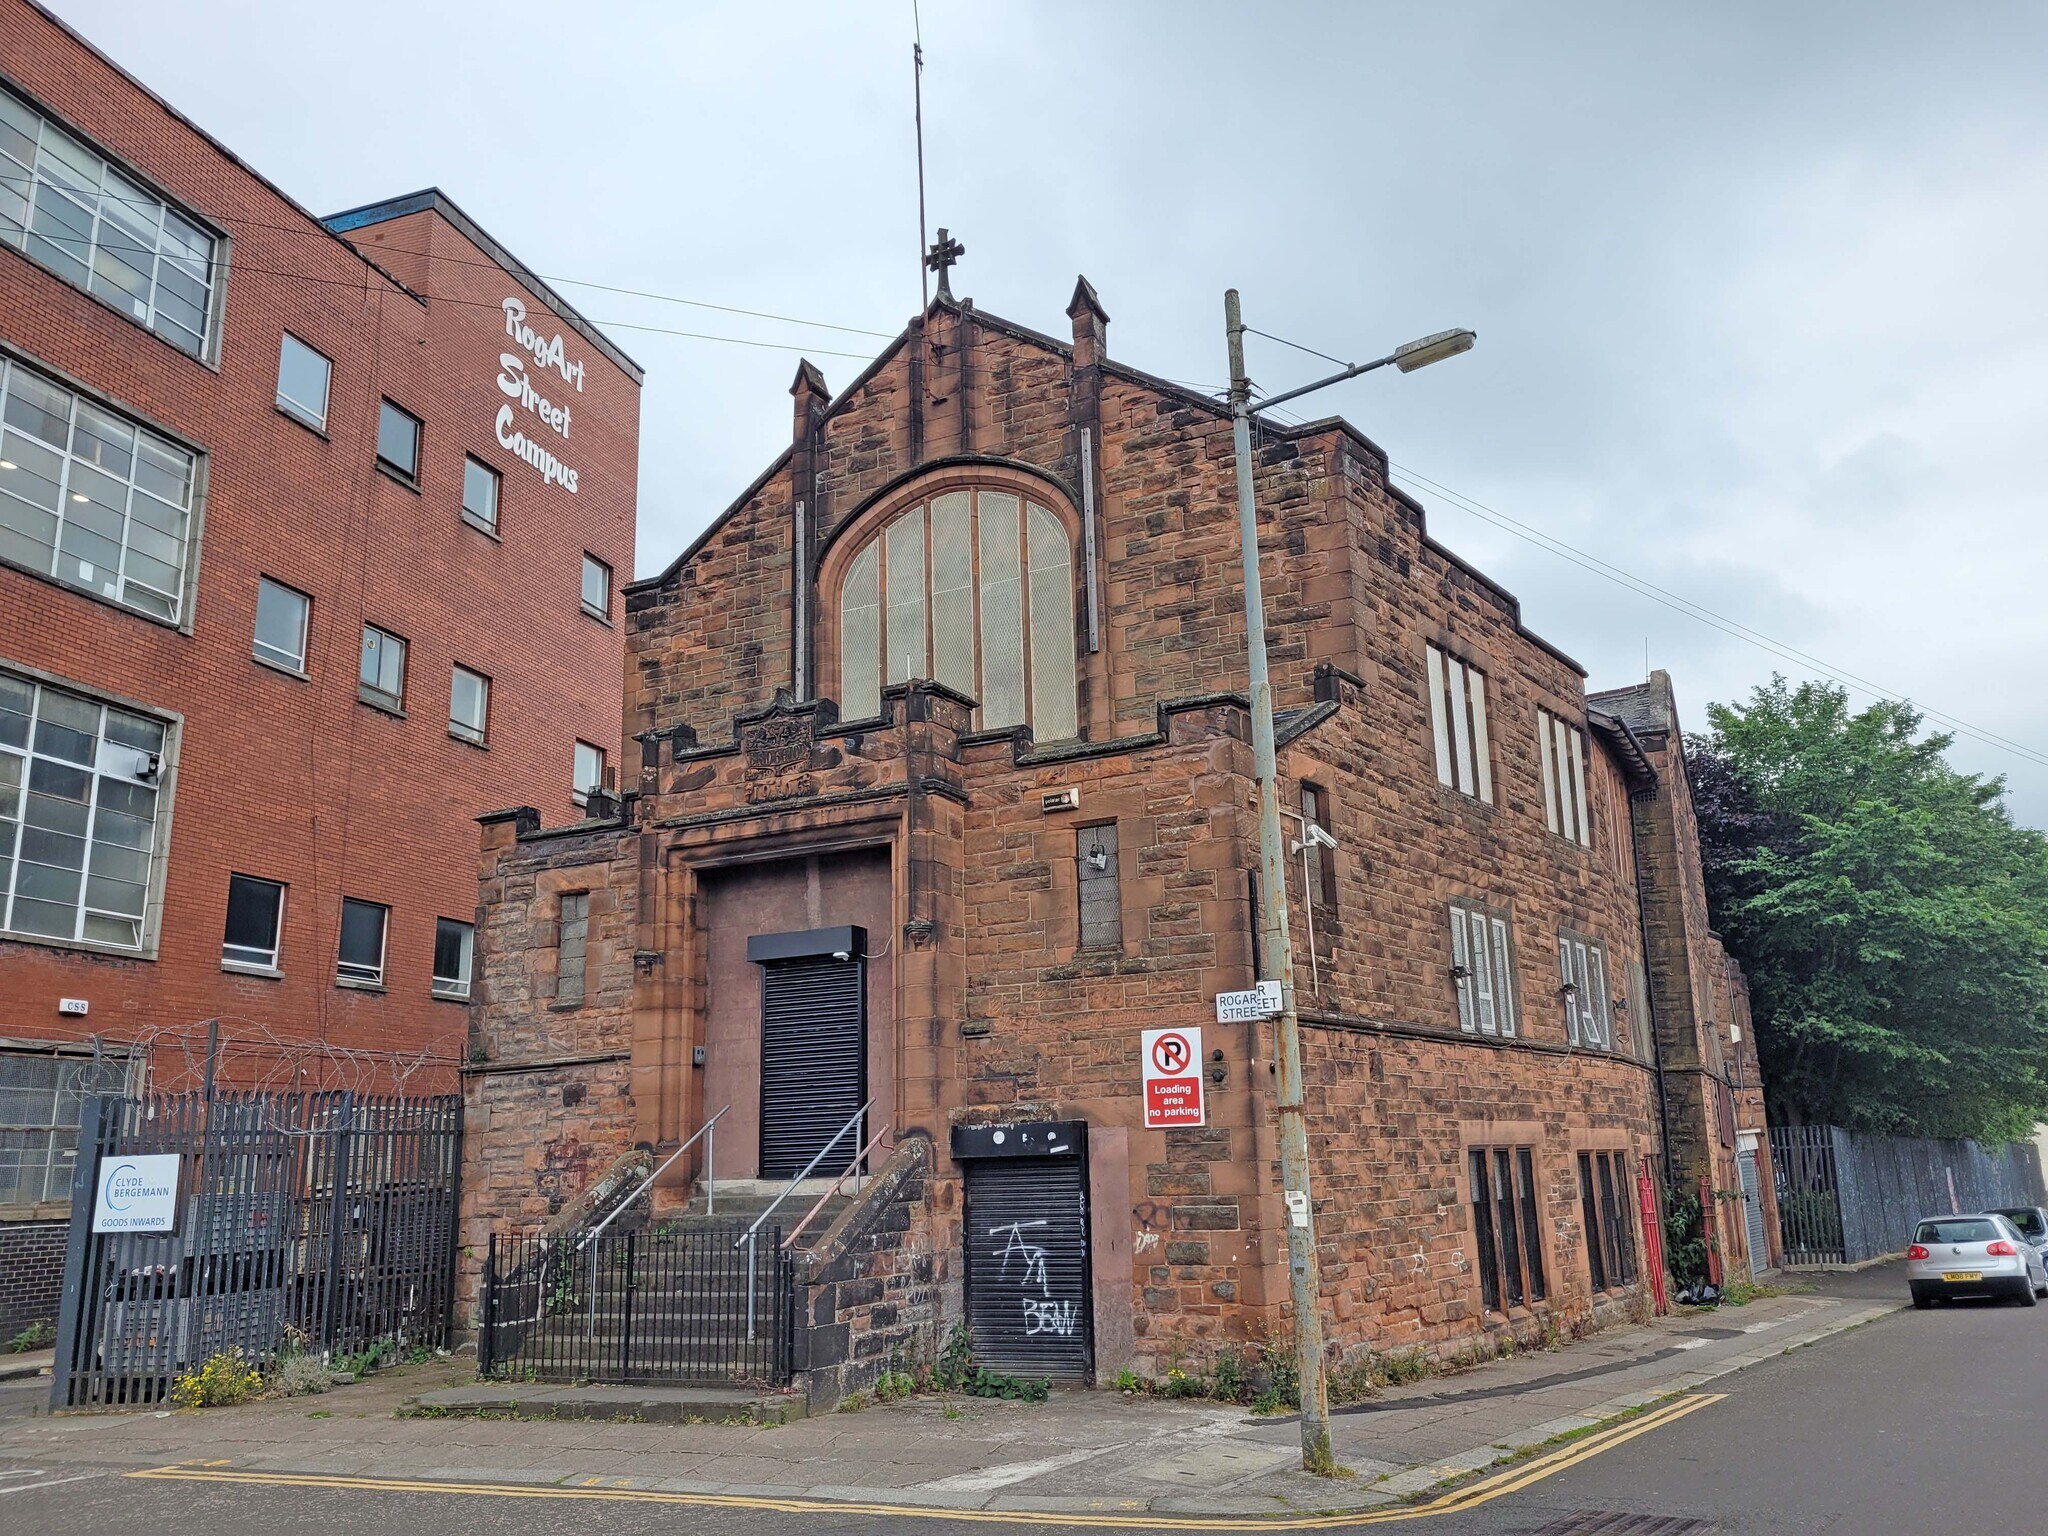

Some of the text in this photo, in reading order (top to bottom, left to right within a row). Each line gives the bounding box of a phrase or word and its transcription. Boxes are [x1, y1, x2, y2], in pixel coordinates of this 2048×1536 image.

[501, 296, 586, 393] RogArt
[496, 353, 572, 438] Street
[495, 403, 579, 494] Campus
[1154, 1084, 1192, 1095] Loading
[1163, 1097, 1184, 1105] area
[1149, 1106, 1199, 1117] no parking
[115, 1177, 143, 1187] CLYDE
[113, 1186, 169, 1198] BERGEMANN
[101, 1216, 166, 1228] GOODS INWARDS
